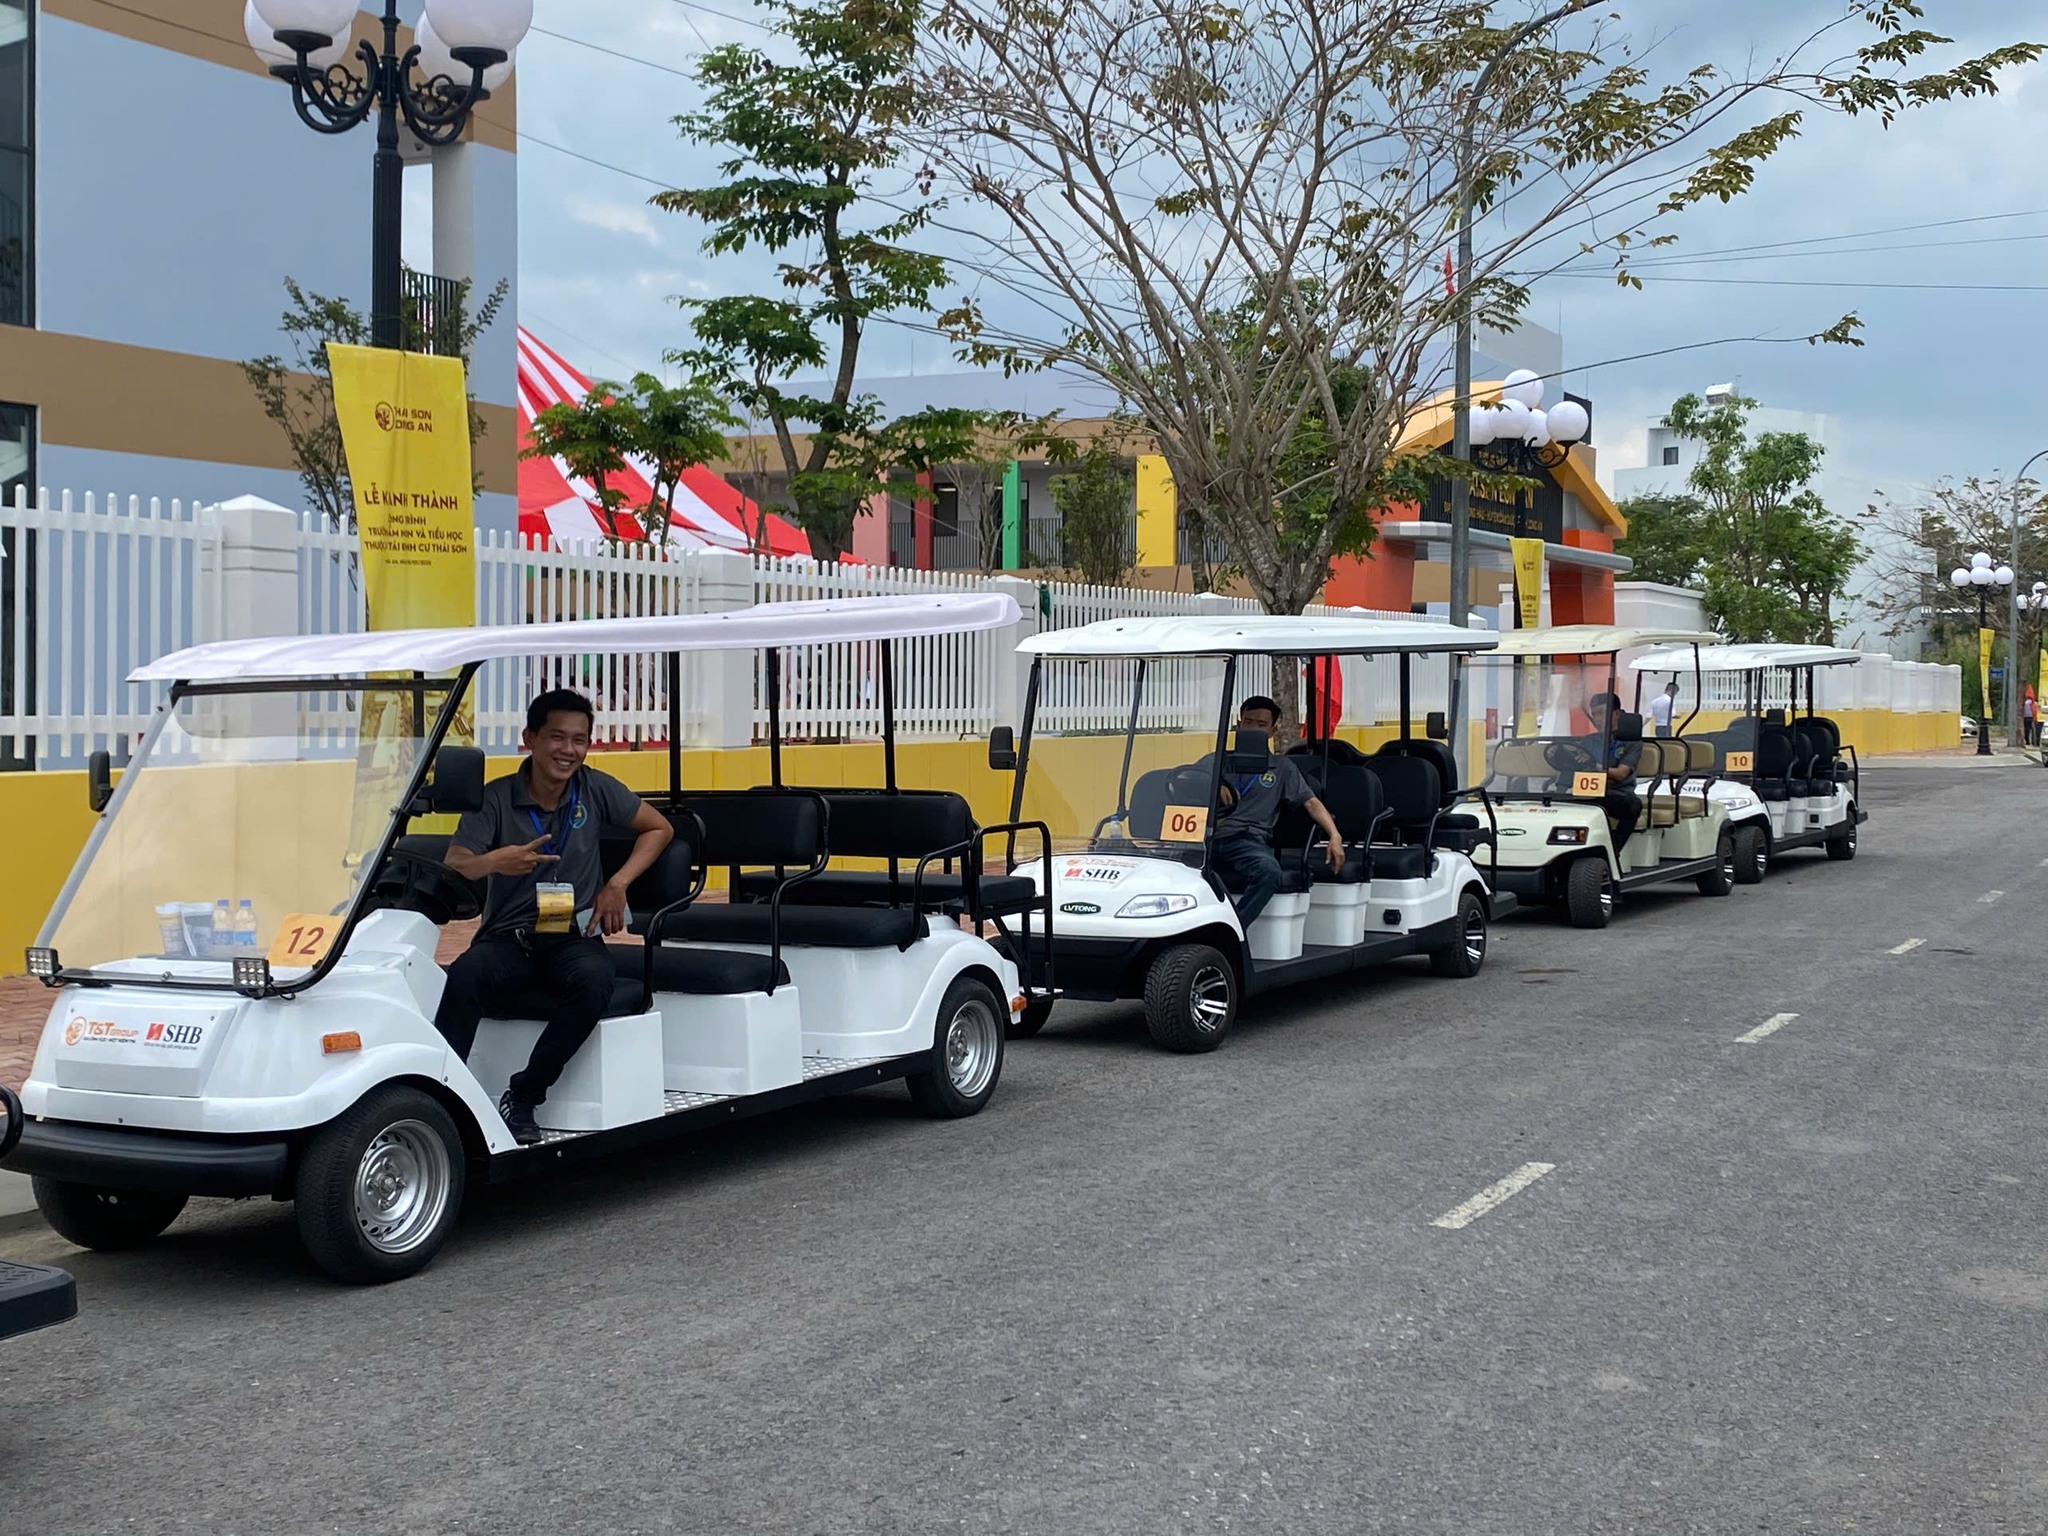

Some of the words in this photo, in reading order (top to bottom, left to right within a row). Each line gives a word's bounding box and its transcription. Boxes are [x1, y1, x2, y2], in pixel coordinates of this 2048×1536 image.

[417, 422, 433, 433] AN
[364, 482, 380, 505] LỄ
[411, 490, 458, 510] THÀNH
[1732, 755, 1748, 767] 10
[1580, 777, 1600, 791] 05
[1171, 813, 1198, 833] 06
[1082, 868, 1120, 880] SHB
[1063, 904, 1098, 912] LVTONG
[287, 926, 324, 955] 12
[163, 1023, 203, 1044] SHB
